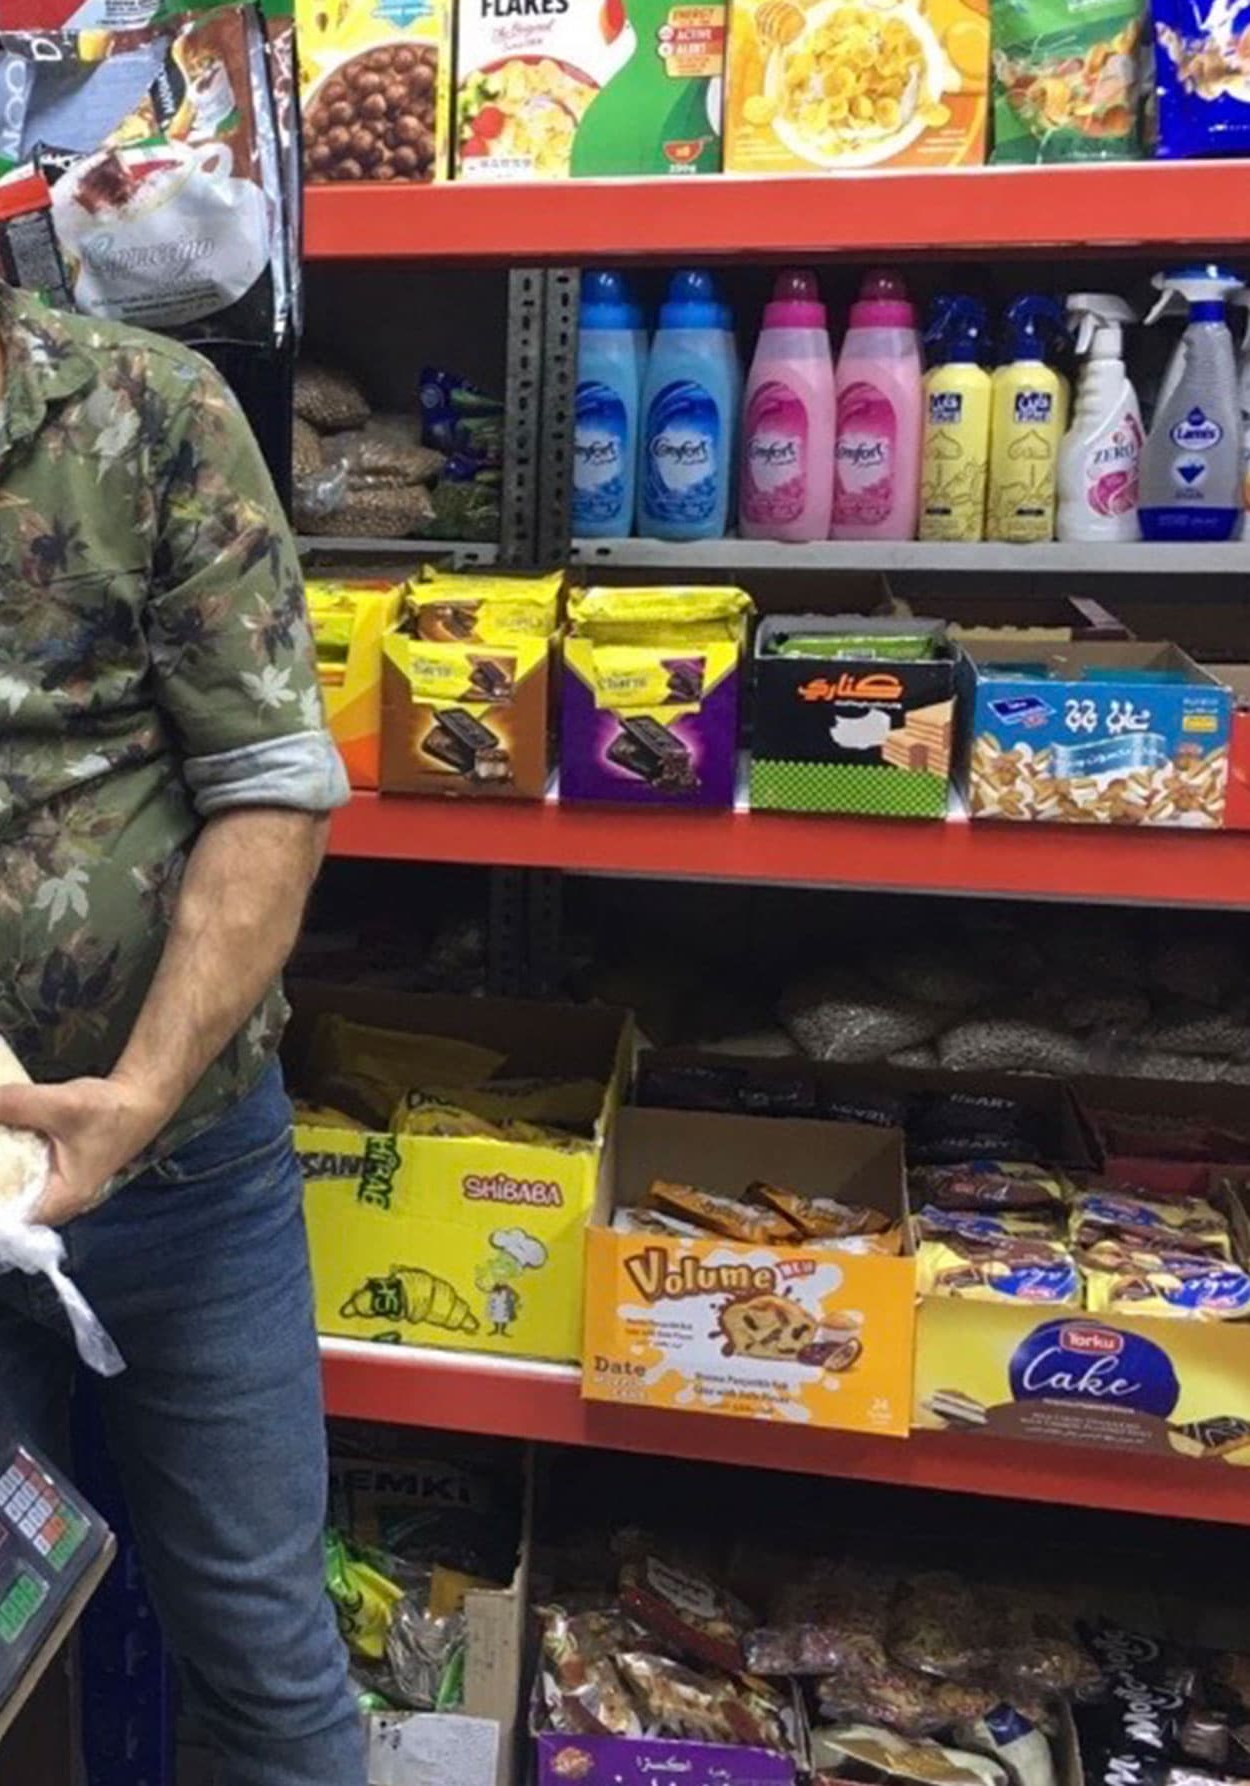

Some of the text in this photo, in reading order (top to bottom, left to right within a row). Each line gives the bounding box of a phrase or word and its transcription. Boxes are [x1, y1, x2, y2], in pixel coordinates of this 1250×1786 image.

[481, 0, 569, 17] FLAKES
[625, 1247, 776, 1300] Volume
[1068, 1329, 1116, 1348] Torku
[594, 1356, 647, 1378] Date
[1022, 1349, 1141, 1395] Cake
